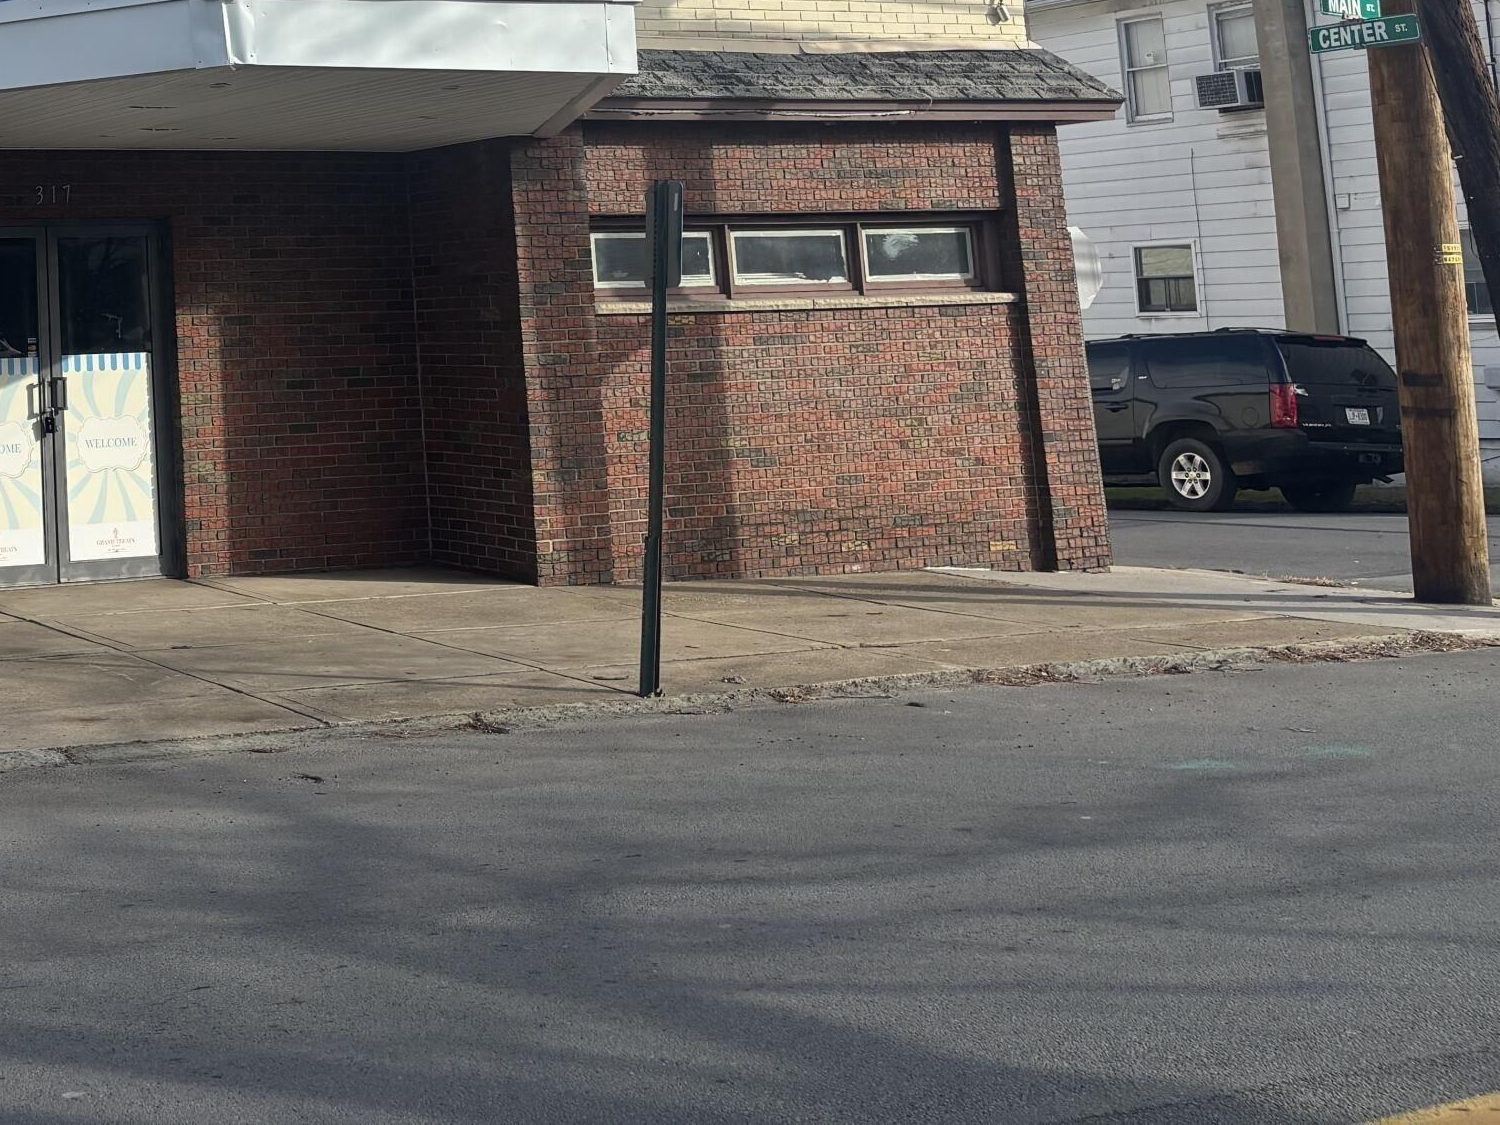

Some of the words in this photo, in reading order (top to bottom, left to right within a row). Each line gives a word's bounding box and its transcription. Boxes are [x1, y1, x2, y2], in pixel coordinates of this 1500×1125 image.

[1319, 21, 1389, 49] CENTER
[1395, 23, 1408, 33] ST.
[35, 184, 70, 205] 317
[85, 437, 138, 449] WELCOME
